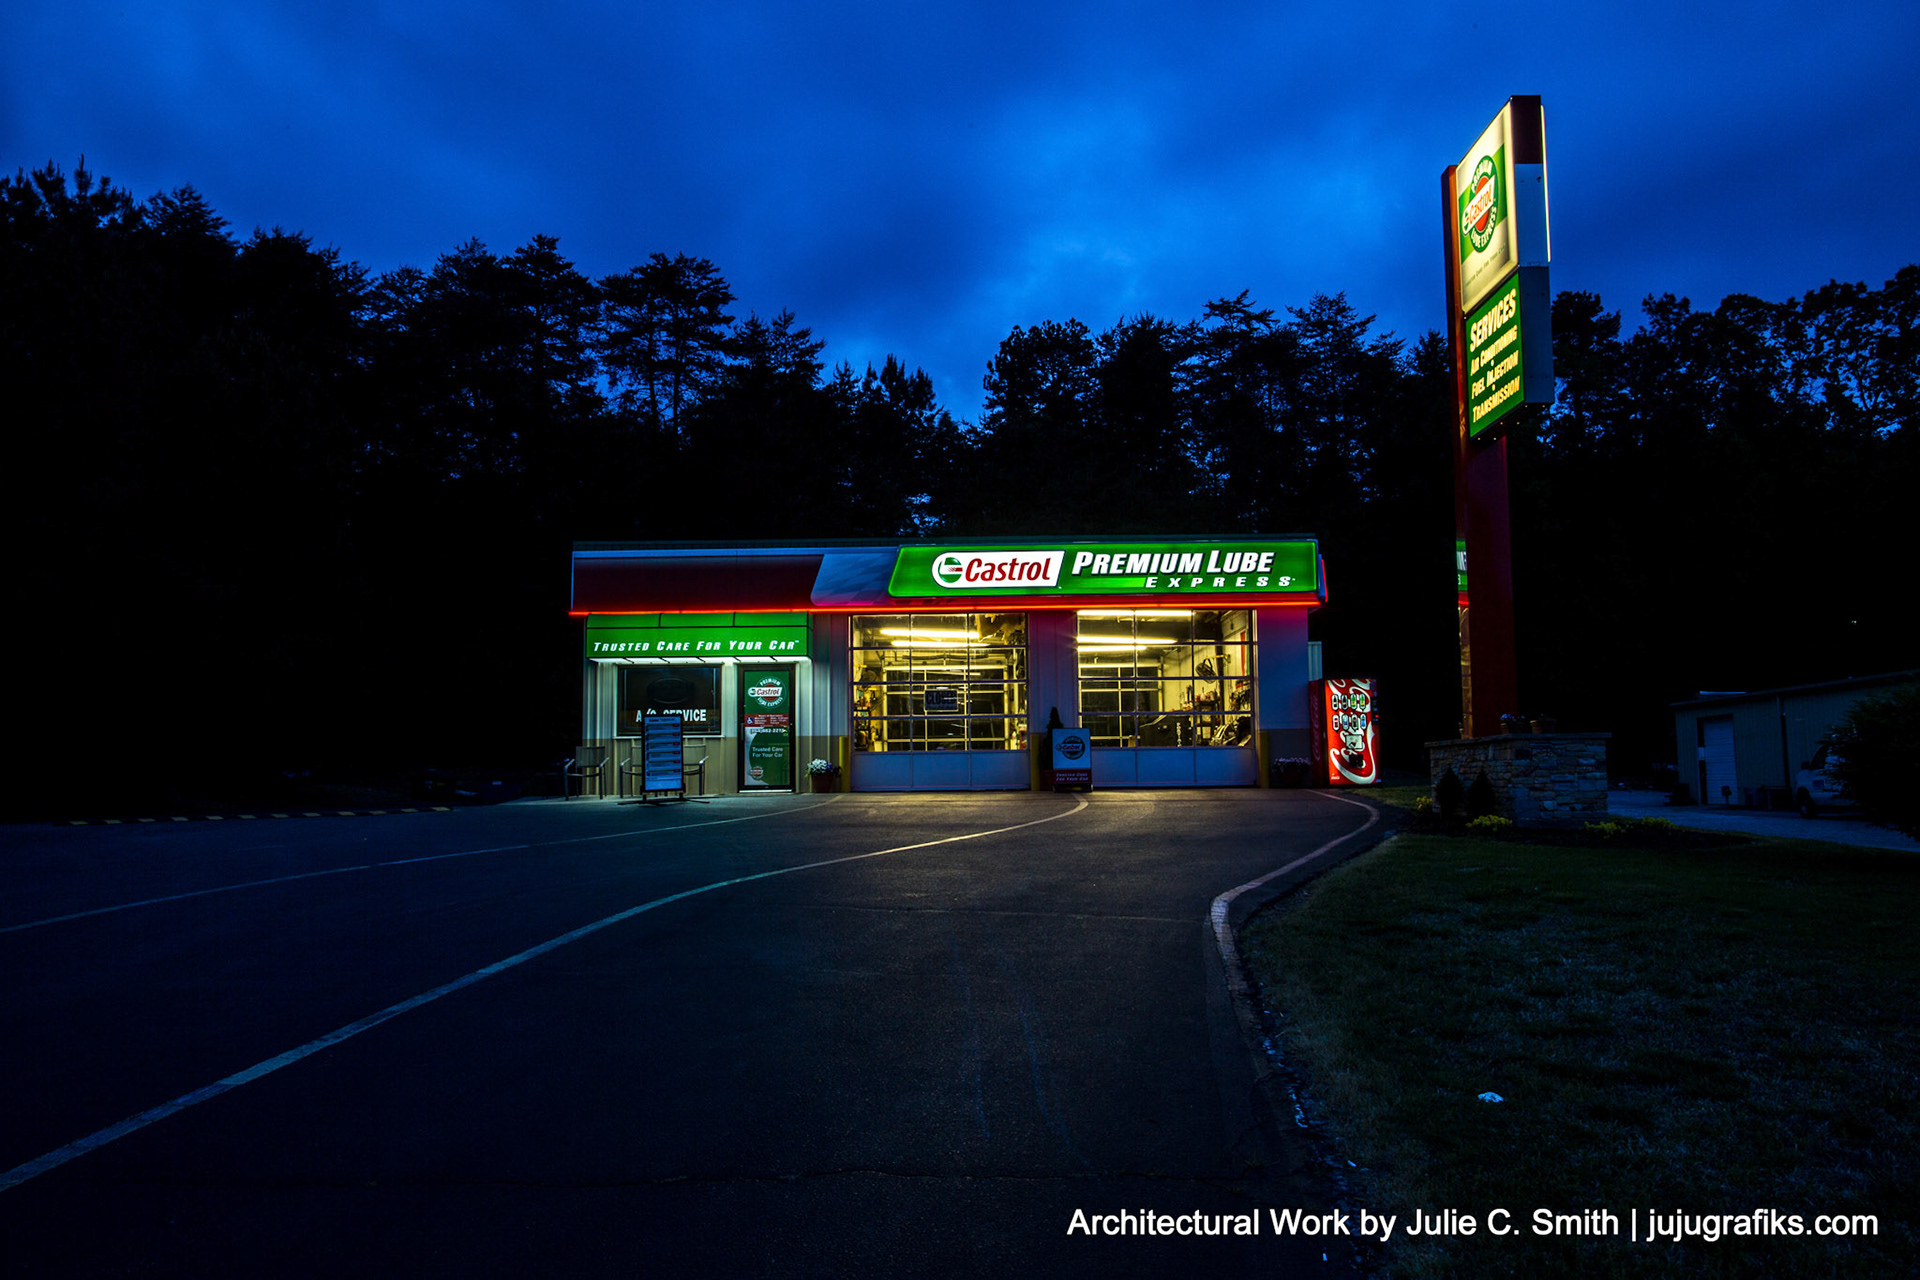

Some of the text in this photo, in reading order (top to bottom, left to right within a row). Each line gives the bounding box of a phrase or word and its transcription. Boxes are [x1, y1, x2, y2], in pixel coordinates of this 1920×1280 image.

[1469, 184, 1492, 225] Castrol
[1470, 288, 1517, 352] SERVICES
[1470, 324, 1518, 376] AIR CONDITIONING
[1471, 349, 1519, 400] FUEL INJECTION
[1472, 375, 1521, 423] TRANSMISSION
[964, 557, 1051, 583] Castrol
[1072, 551, 1274, 574] PREMIUM LUBE
[1146, 577, 1290, 587] EXPRESS
[595, 643, 649, 651] TRUSTED
[657, 641, 689, 650] CARE
[697, 641, 720, 650] FOR
[730, 641, 762, 650] YOUR
[756, 688, 780, 696] Castrol
